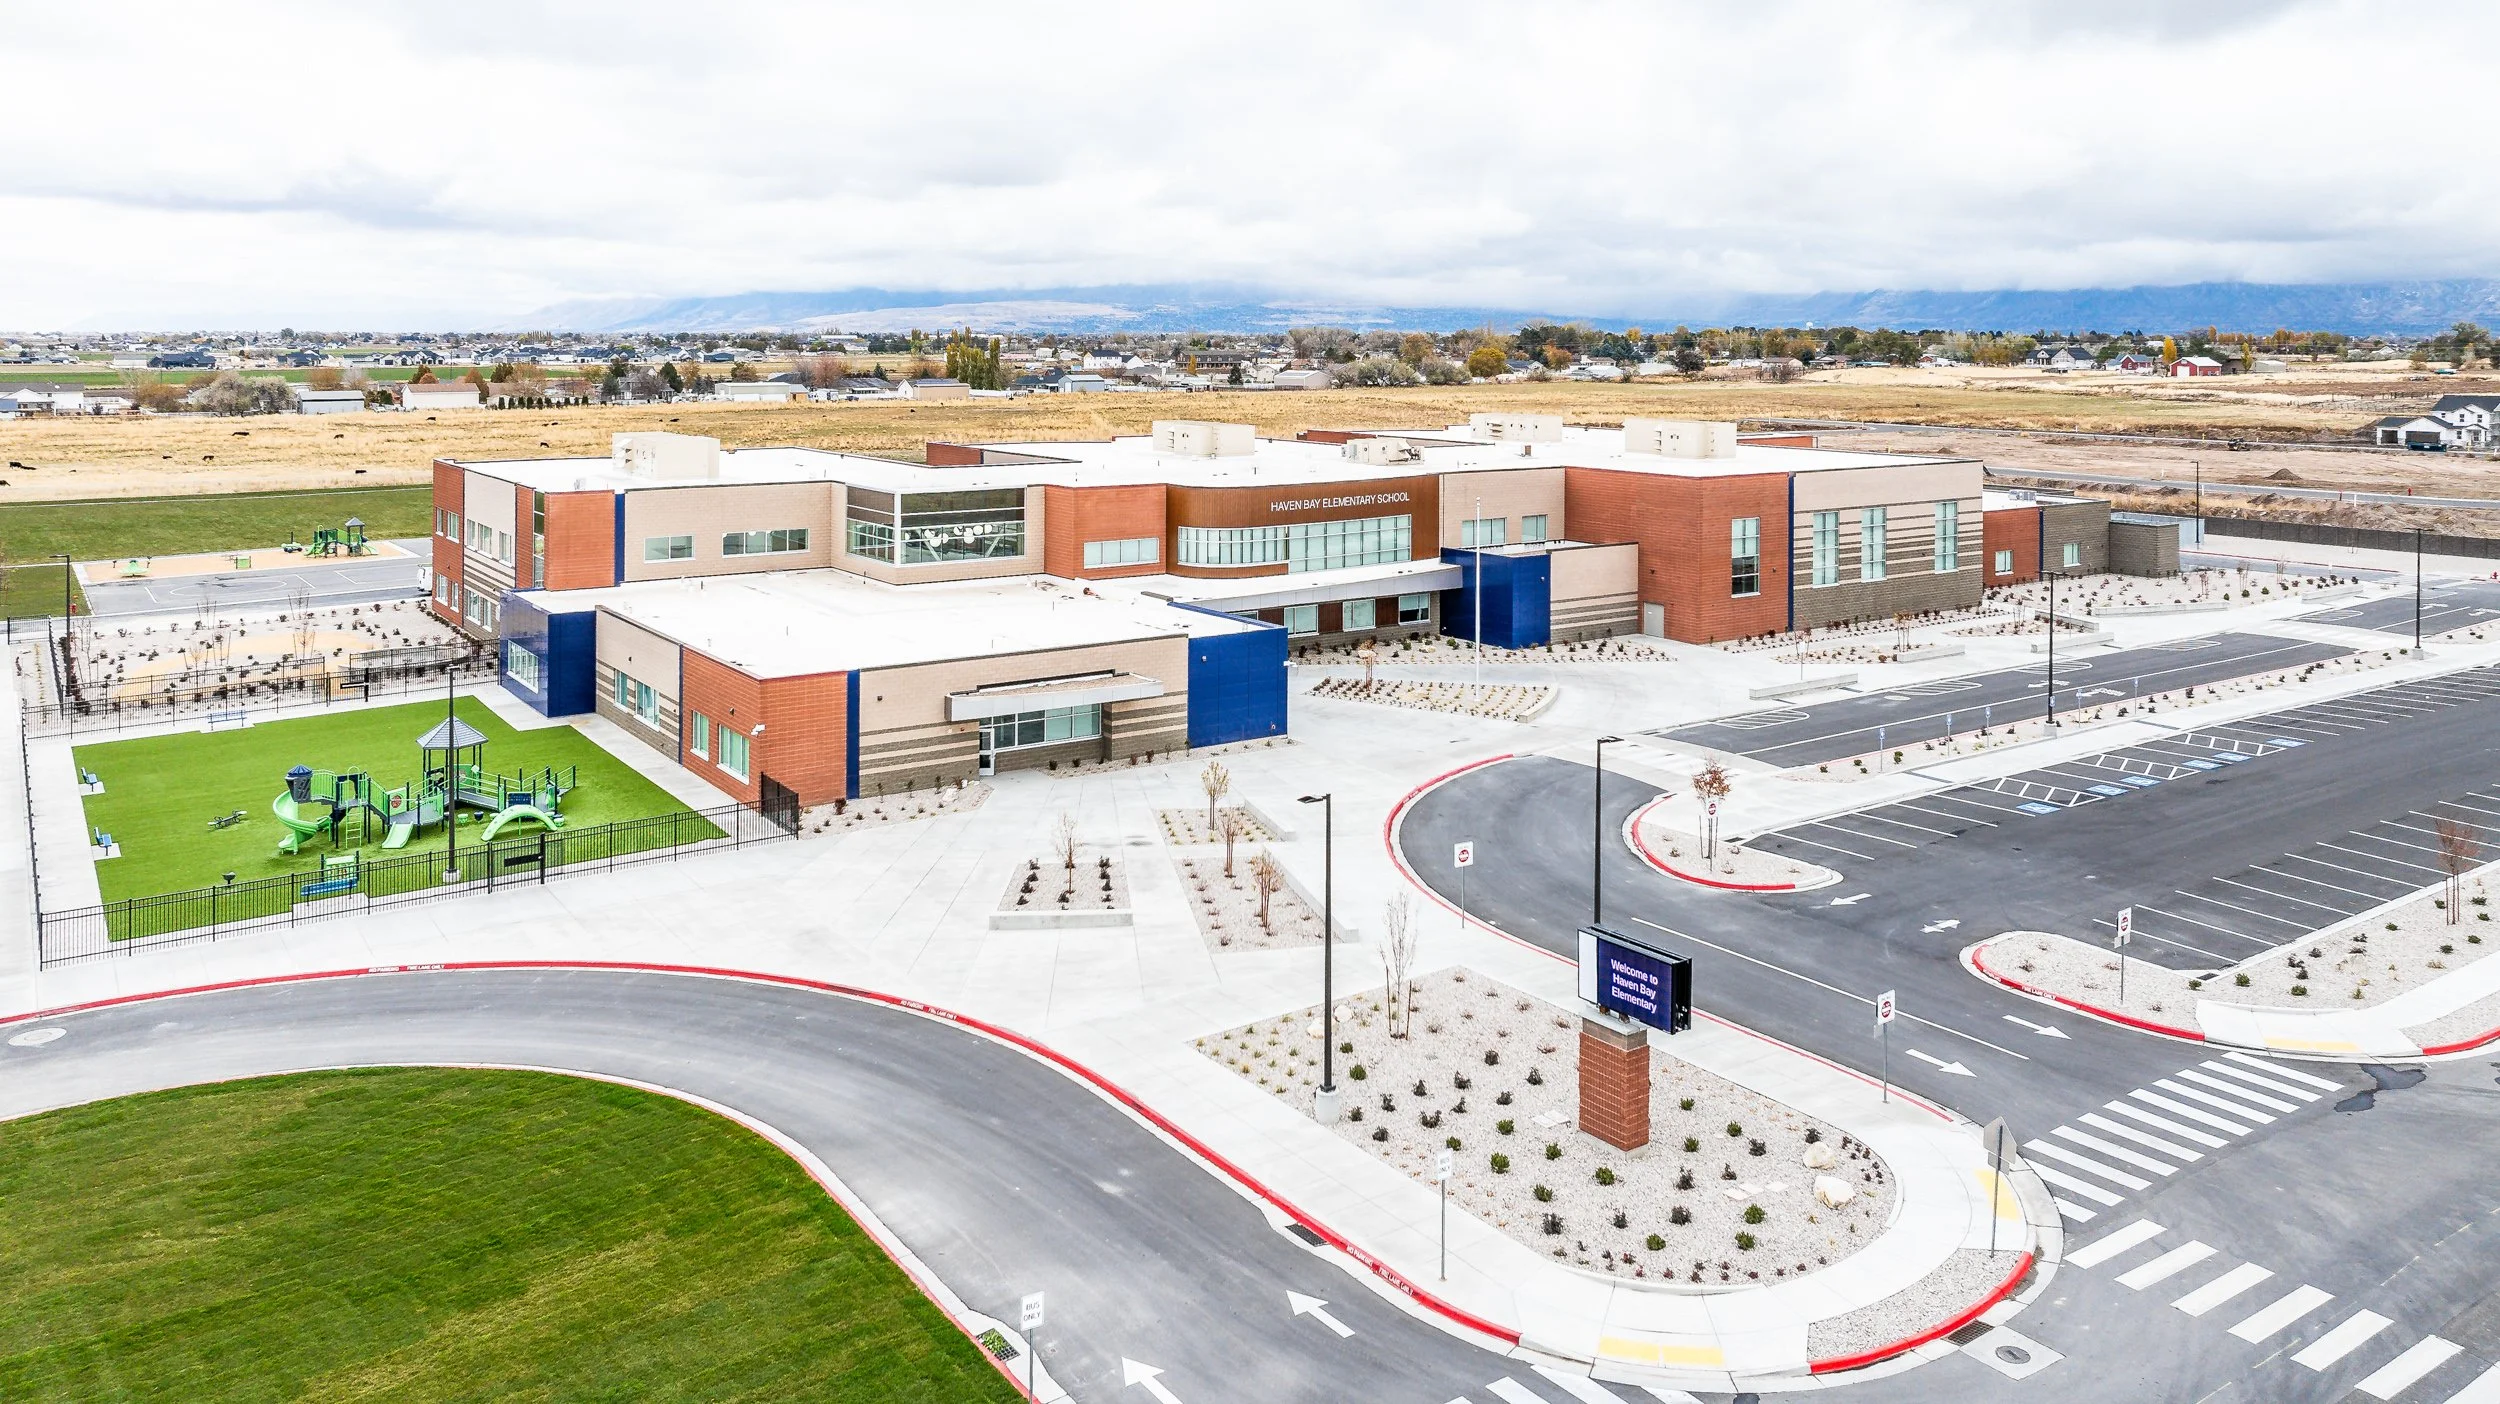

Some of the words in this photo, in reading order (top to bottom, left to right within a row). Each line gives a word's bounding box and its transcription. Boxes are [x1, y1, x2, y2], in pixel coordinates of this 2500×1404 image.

[1270, 500, 1302, 512] HAVEN
[1303, 498, 1320, 510] BAY
[1322, 494, 1377, 508] ELEMENTARY
[1377, 492, 1410, 504] SCHOOL
[1610, 958, 1648, 982] Welcome
[1649, 974, 1659, 986] to
[1612, 973, 1639, 992] Haven
[1640, 984, 1657, 1000] Bay
[1611, 986, 1657, 1014] Elementary
[1023, 1311, 1041, 1321] ONLY
[1026, 1302, 1040, 1311] BUS
